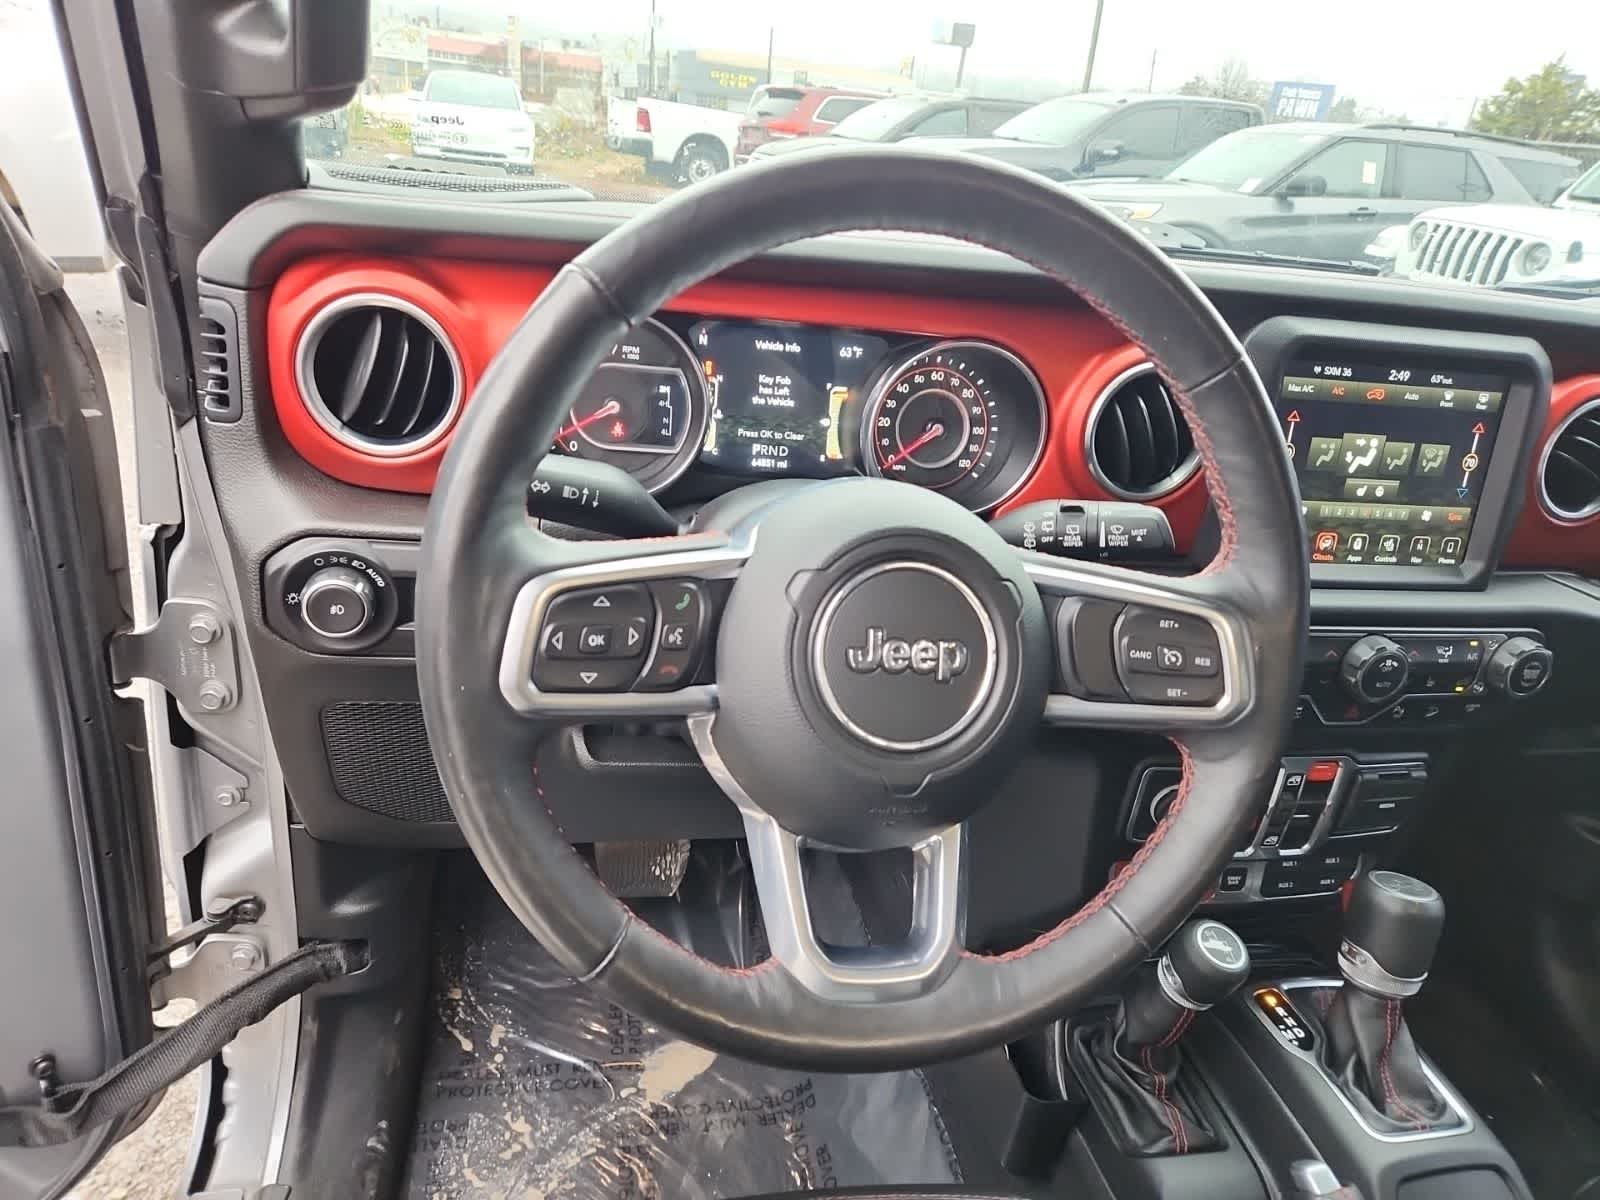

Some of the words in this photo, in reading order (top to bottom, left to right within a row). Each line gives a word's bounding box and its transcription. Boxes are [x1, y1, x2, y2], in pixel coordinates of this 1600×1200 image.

[622, 345, 640, 354] RPM
[755, 340, 784, 351] Vehicle
[785, 342, 801, 353] Info
[930, 371, 945, 381] 60
[1323, 366, 1341, 376] SXM
[1388, 369, 1411, 382] 2:49
[759, 374, 774, 385] Key
[775, 375, 791, 385] Fob
[914, 375, 925, 383] 50
[950, 378, 960, 386] 70
[758, 385, 773, 395] has
[774, 386, 790, 396] Left
[896, 384, 909, 393] 40
[962, 389, 974, 398] 80
[1404, 392, 1419, 400] Auto
[752, 396, 766, 405] the
[766, 397, 794, 407] Vehicle
[886, 400, 896, 408] 30
[972, 406, 982, 415] 90
[878, 417, 890, 426] 20
[738, 428, 759, 438] Press
[760, 430, 773, 438] OK
[774, 431, 782, 439] to
[784, 432, 805, 441] Clear
[972, 427, 985, 435] 100
[569, 440, 578, 451] 0
[881, 438, 889, 446] 10
[752, 443, 789, 457] PRND
[958, 459, 971, 468] 120
[366, 568, 385, 587] AUTO
[588, 634, 605, 647] OK
[847, 626, 968, 684] Jeep
[1130, 649, 1152, 660] CANC
[550, 1077, 609, 1092] COVE
[716, 1077, 814, 1114] PROTECTIVE
